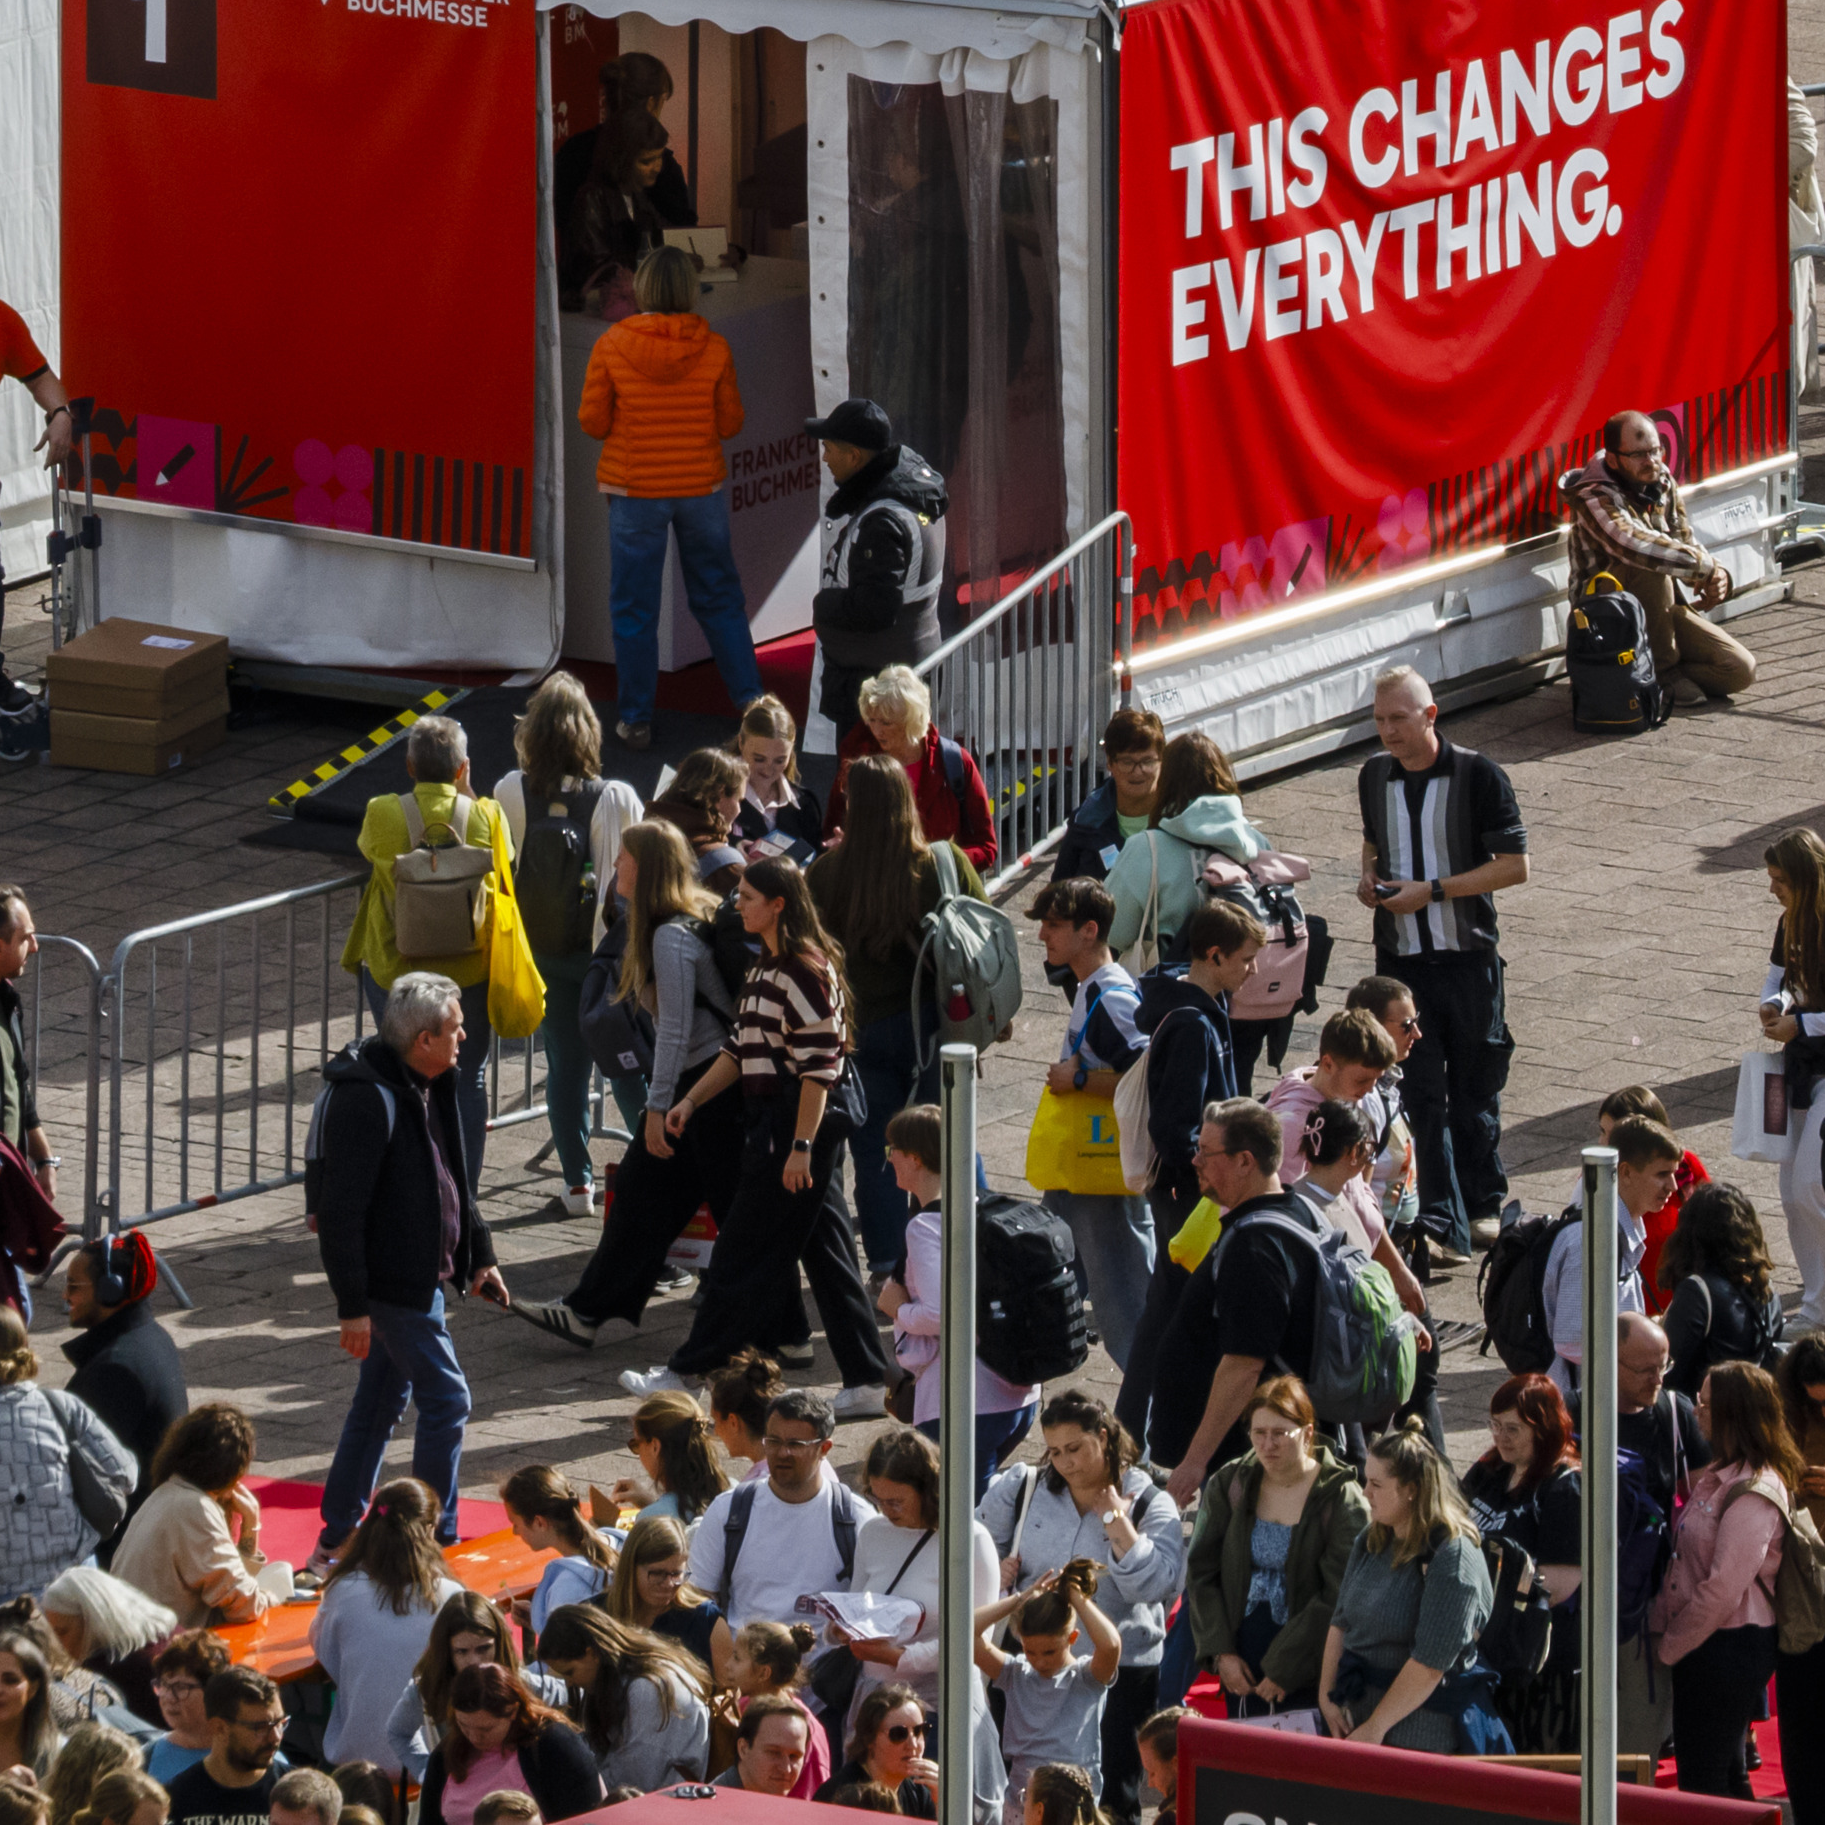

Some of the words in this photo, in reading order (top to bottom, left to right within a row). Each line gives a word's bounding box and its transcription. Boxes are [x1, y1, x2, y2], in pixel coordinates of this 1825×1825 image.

[1170, 106, 1329, 239] THIS
[1172, 148, 1623, 367] EVERYTHING.
[1723, 499, 1753, 521] MUCH
[1150, 688, 1179, 707] MUCH
[1087, 1115, 1114, 1144] L
